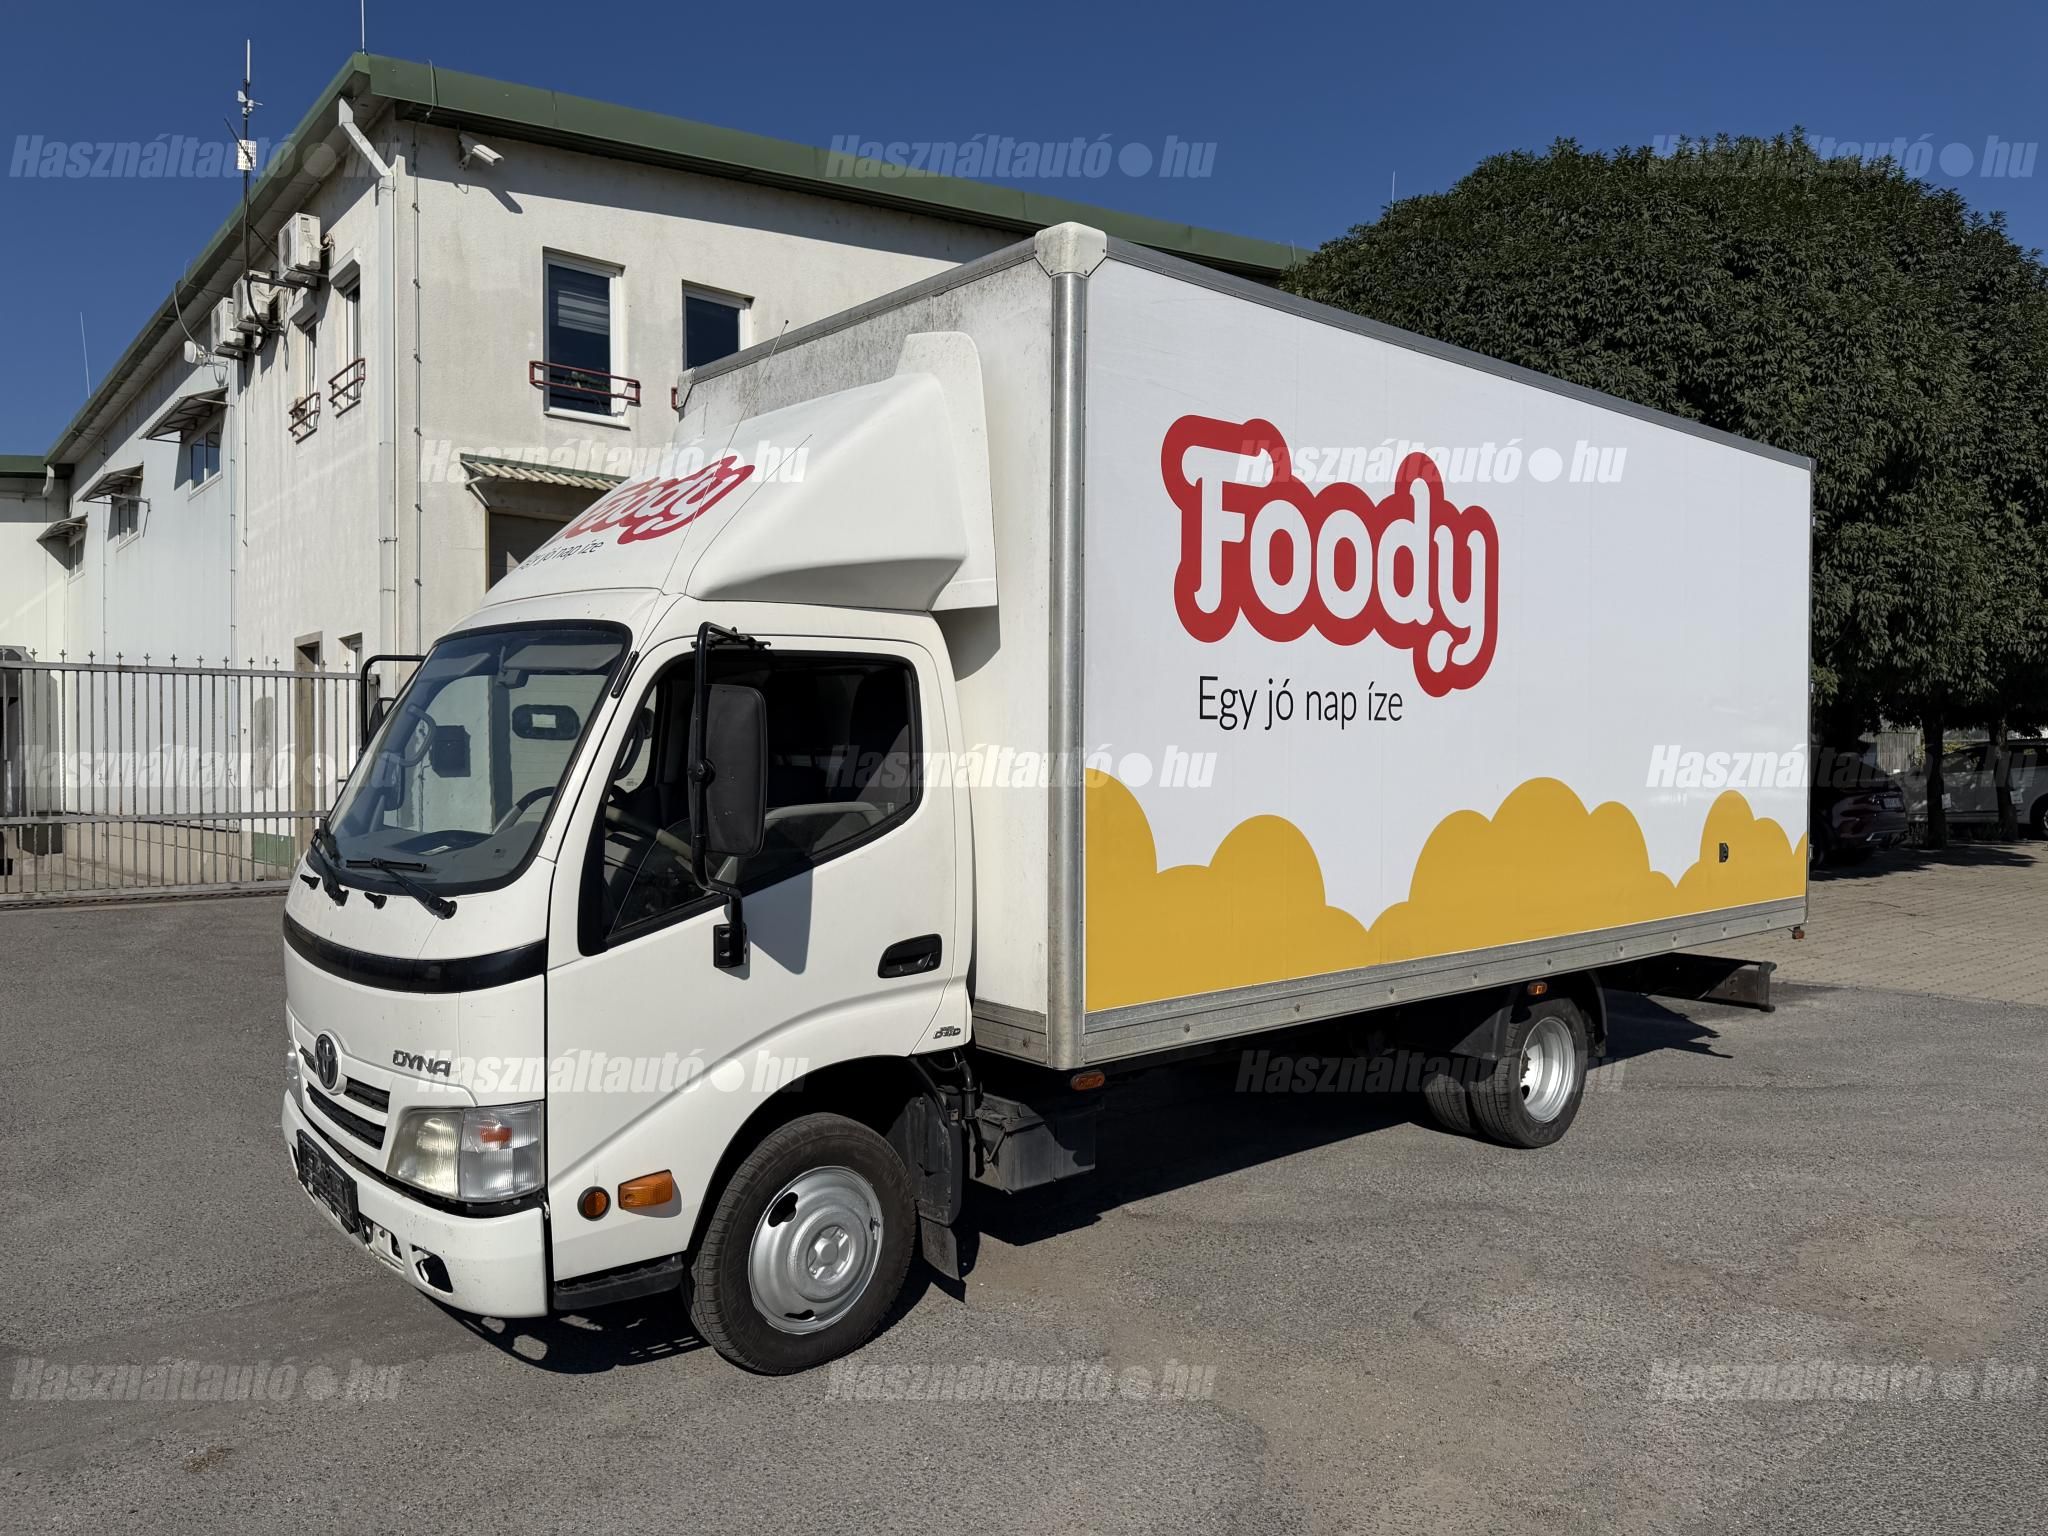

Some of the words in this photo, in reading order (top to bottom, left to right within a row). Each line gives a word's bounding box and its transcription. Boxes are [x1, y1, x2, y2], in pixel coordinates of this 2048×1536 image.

[1180, 440, 1488, 676] Foody
[1199, 675, 1257, 731] Egy
[1264, 679, 1294, 731] jó
[1305, 688, 1357, 731] nap
[1367, 681, 1404, 722] íze
[393, 1049, 451, 1077] DYNA
